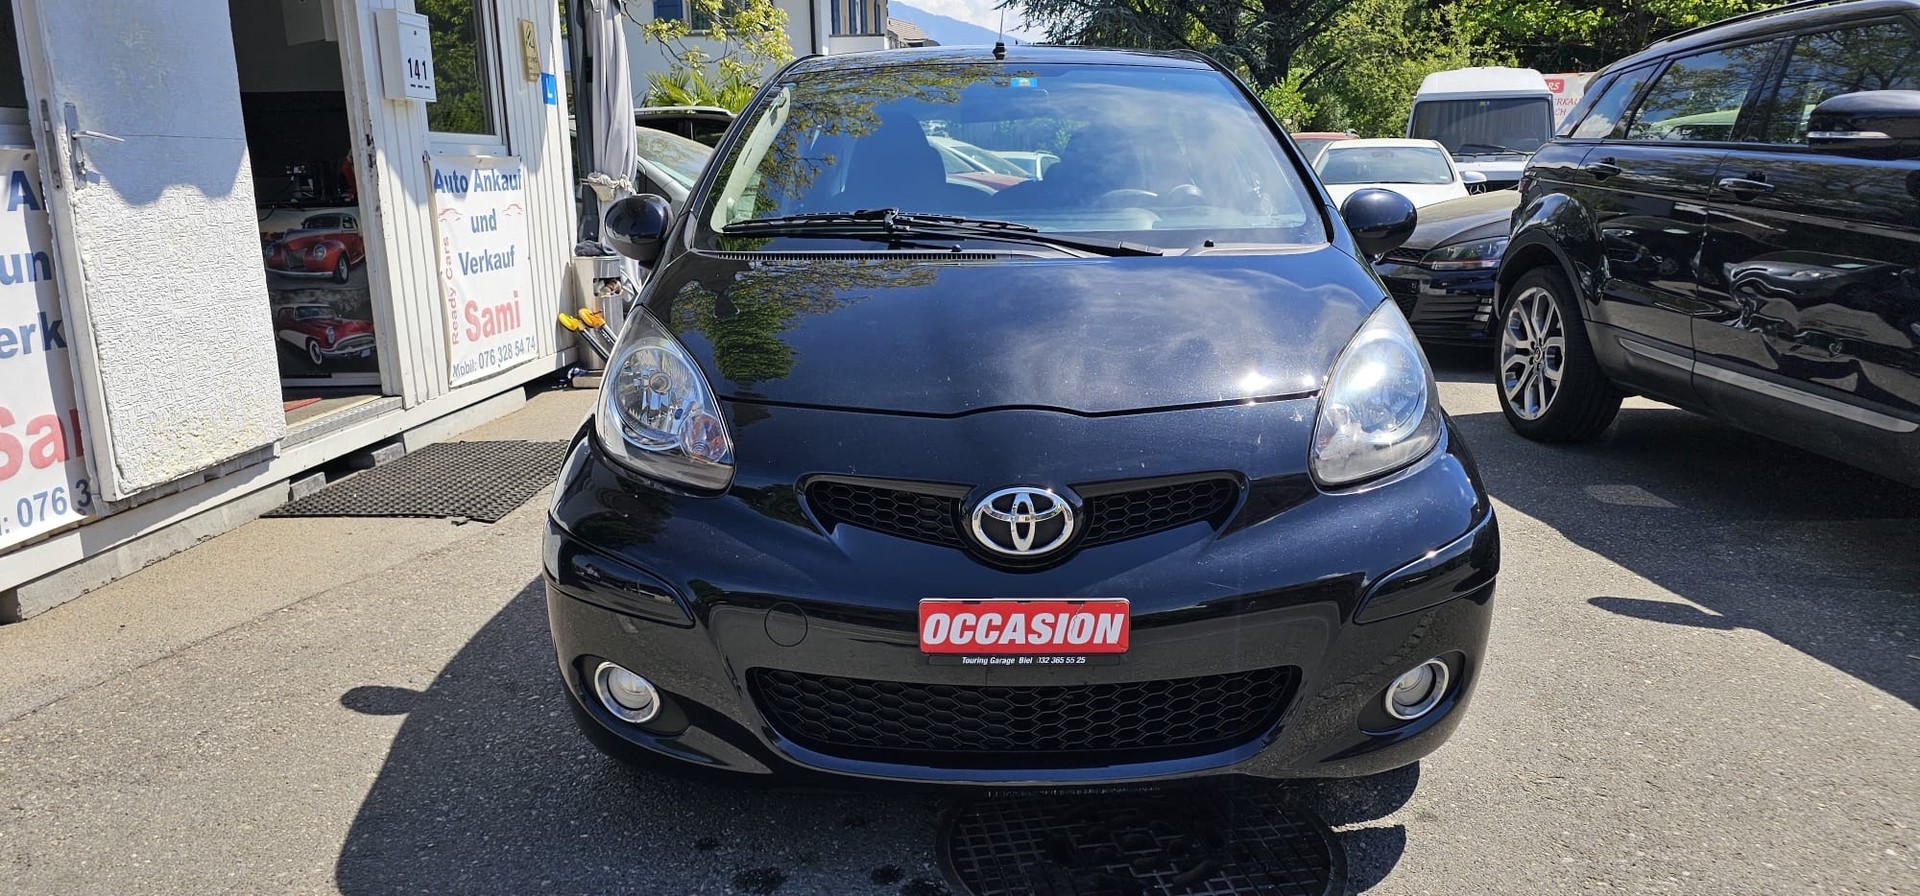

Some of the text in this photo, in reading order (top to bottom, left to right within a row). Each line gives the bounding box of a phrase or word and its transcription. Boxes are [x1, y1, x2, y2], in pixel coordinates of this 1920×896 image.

[407, 57, 428, 81] 141
[545, 77, 554, 99] L
[7, 170, 47, 212] A
[433, 167, 523, 194] Auto Ankauf
[470, 208, 498, 234] und
[458, 244, 516, 276] Verkauf
[443, 236, 460, 346] Ready Cars
[464, 289, 521, 343] Sami
[452, 334, 537, 379] Mobil: 076 328 54 74
[0, 405, 85, 483] Sa
[16, 485, 68, 528] 076
[922, 612, 1125, 646] OCCASION
[962, 656, 989, 666] Touring
[990, 656, 1016, 666] Garage
[1018, 656, 1033, 664] Biel
[1051, 656, 1065, 664] 365
[1065, 656, 1075, 664] 55
[1076, 656, 1086, 664] 25
